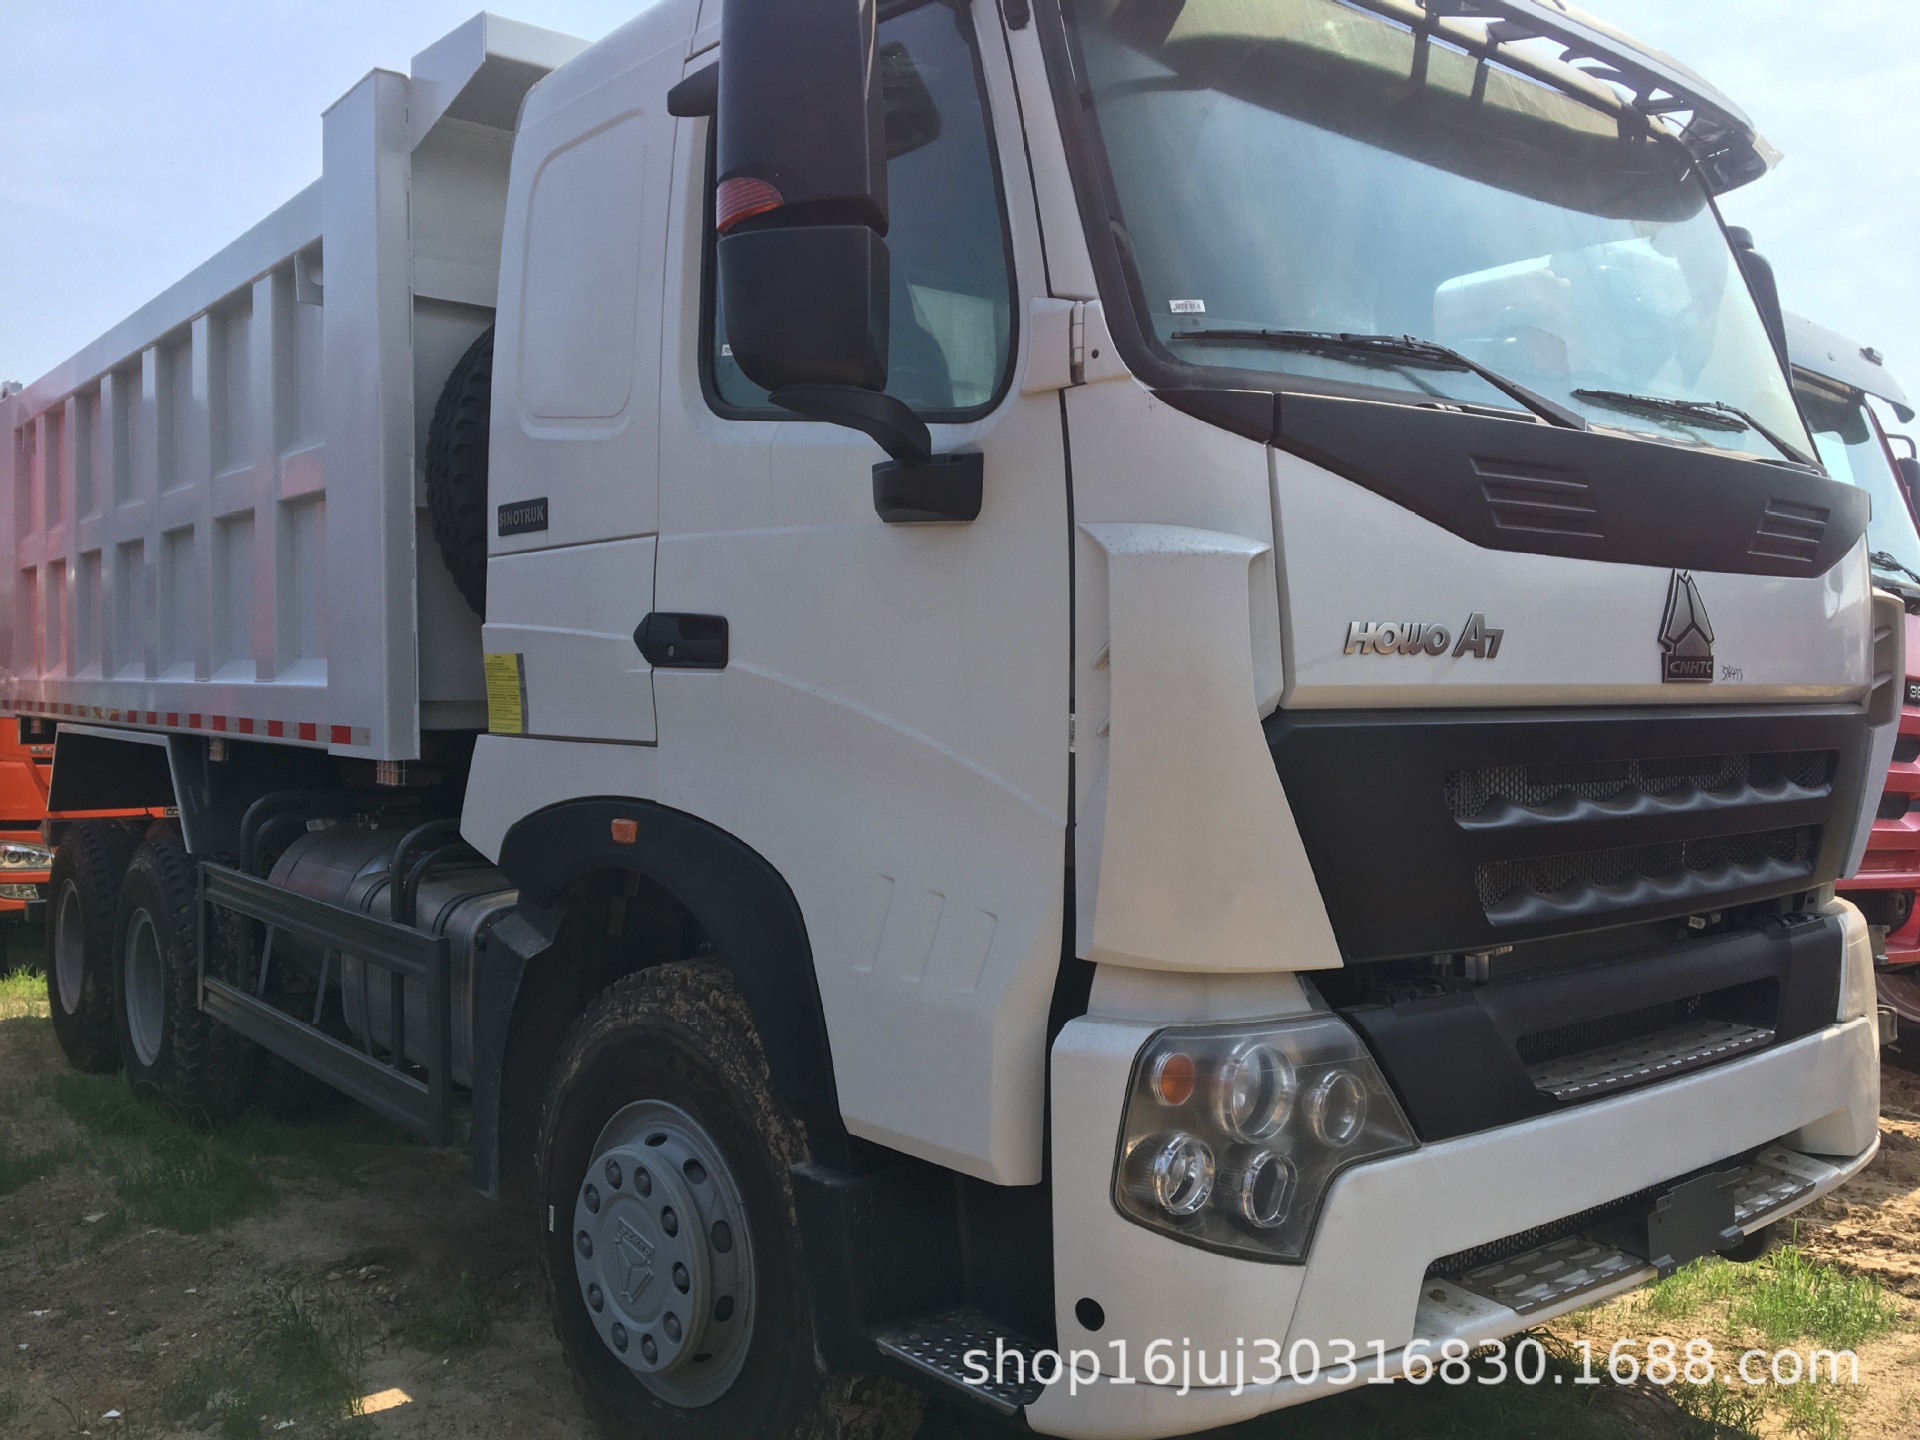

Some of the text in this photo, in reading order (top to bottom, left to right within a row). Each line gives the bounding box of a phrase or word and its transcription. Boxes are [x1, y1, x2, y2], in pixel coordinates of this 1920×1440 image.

[499, 505, 545, 528] SINOTRUK
[1344, 611, 1505, 659] HOWO A7
[1669, 661, 1713, 674] CNHTC
